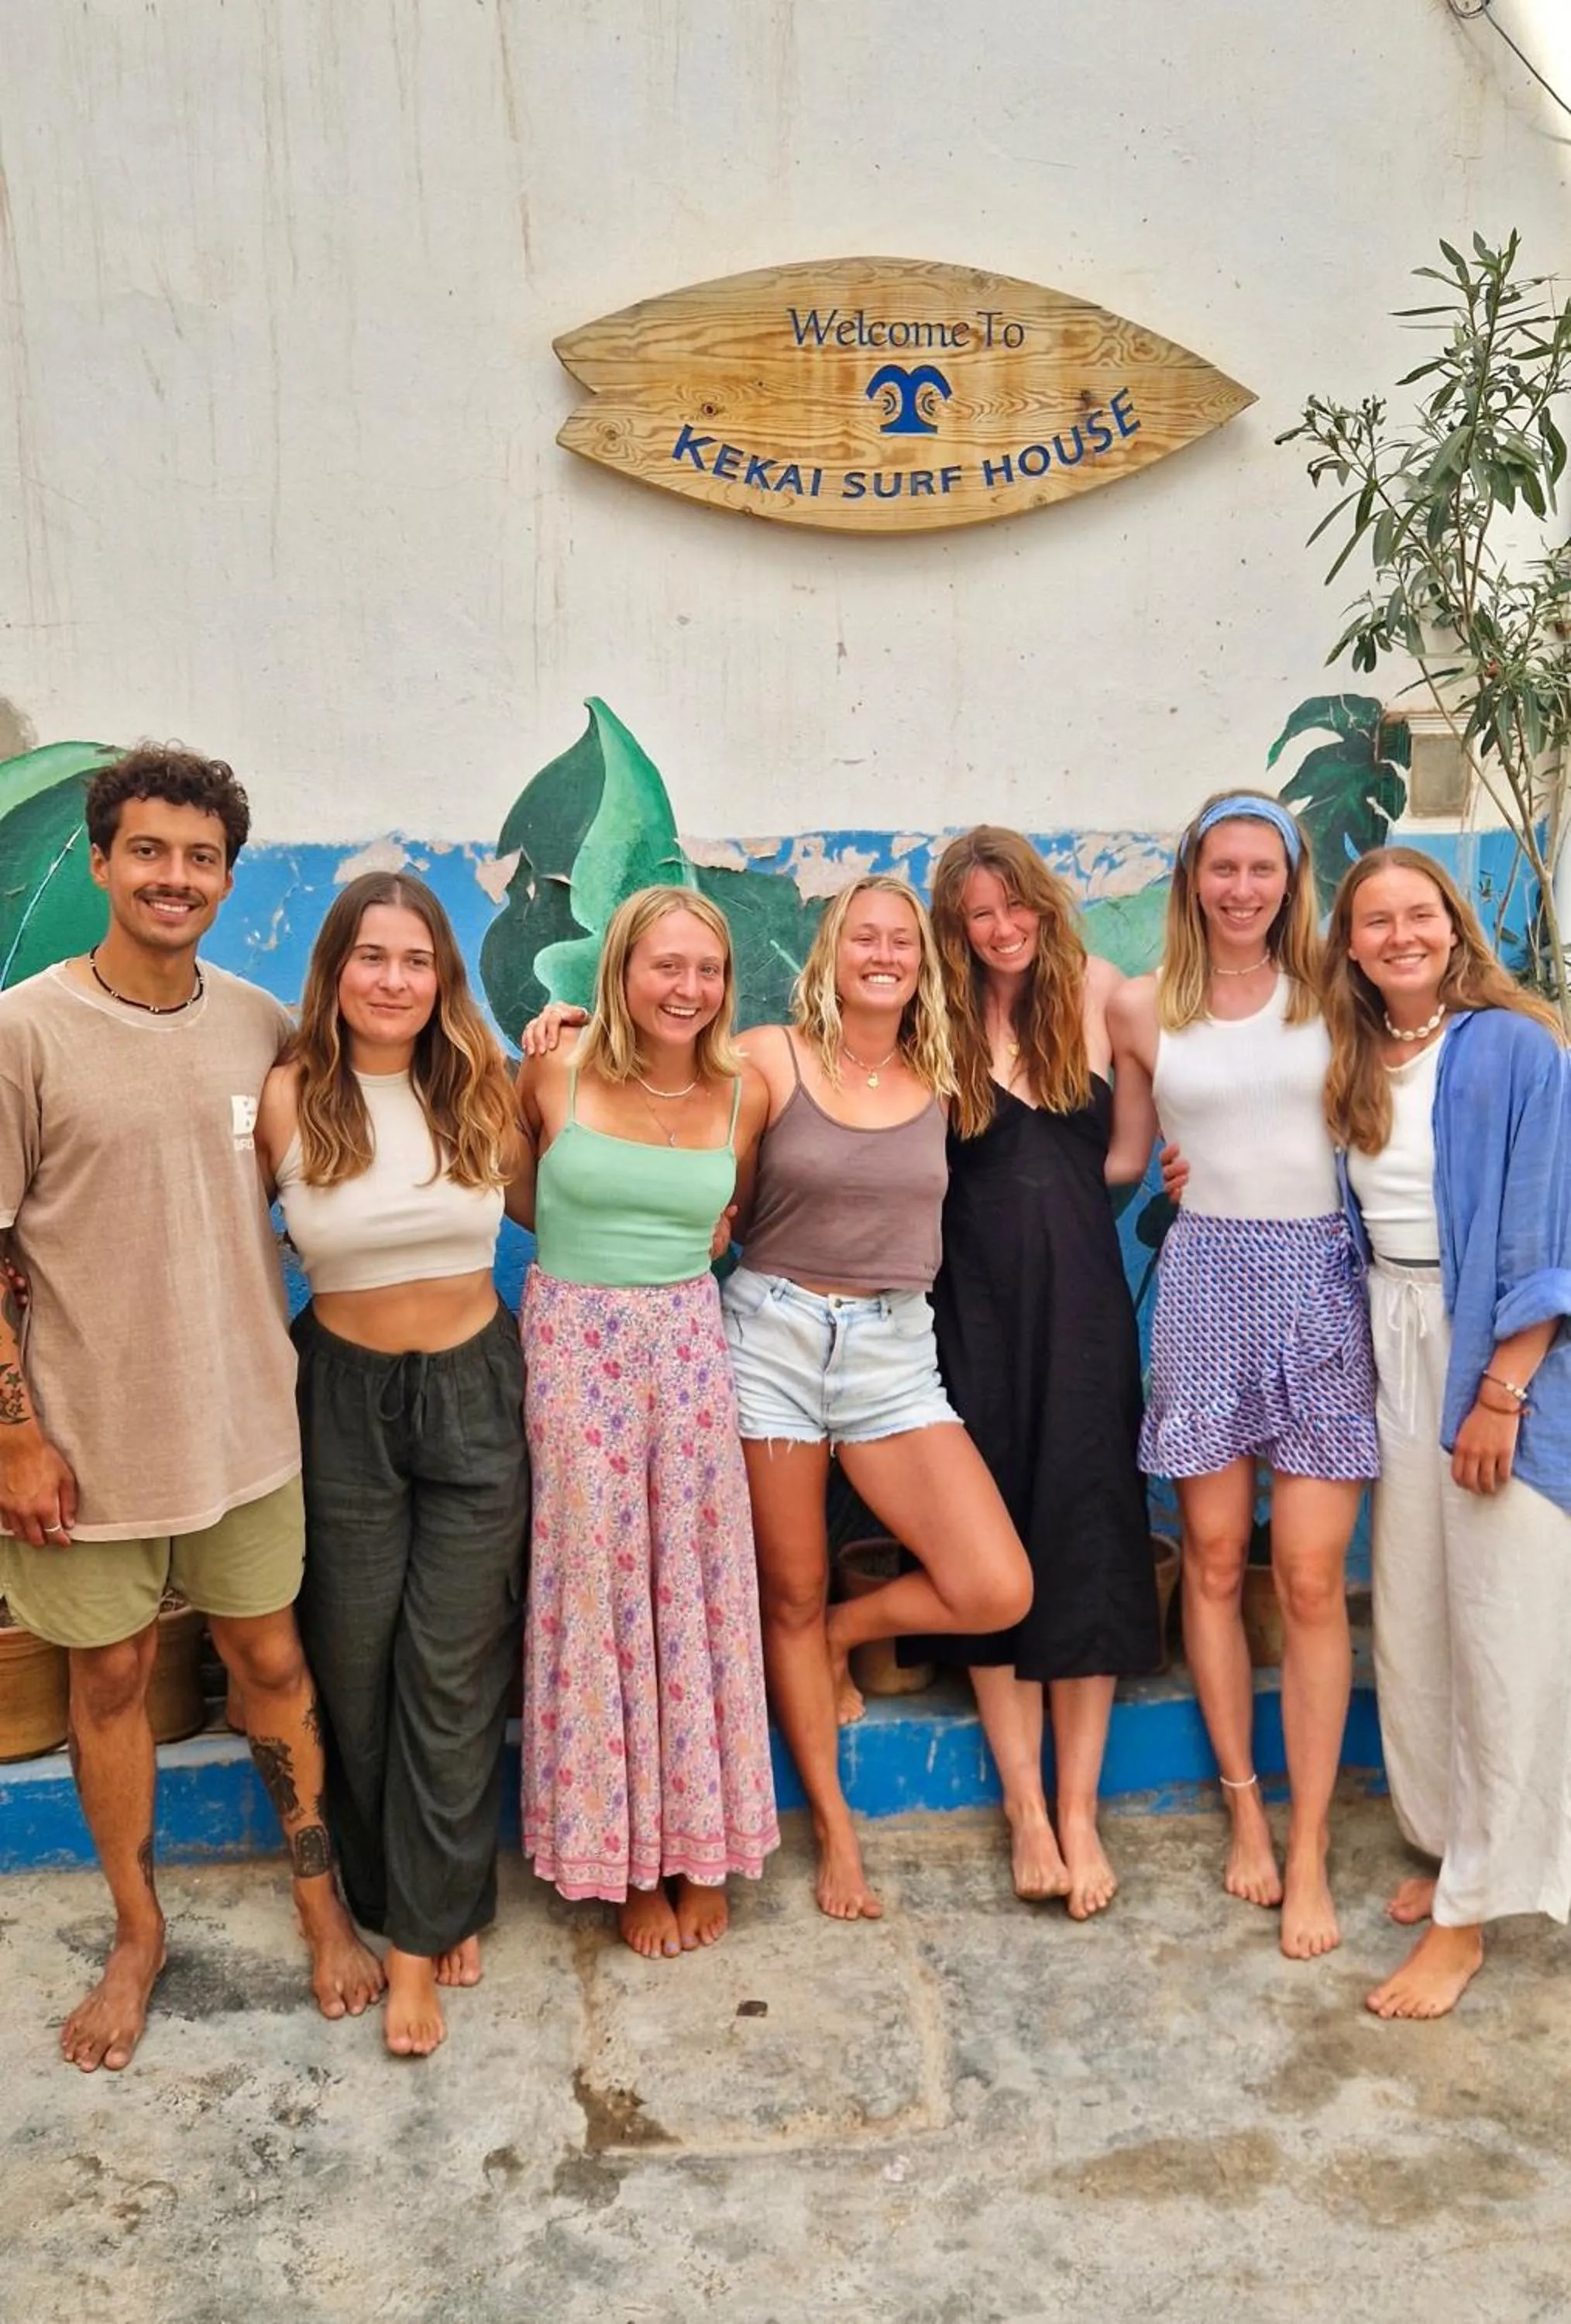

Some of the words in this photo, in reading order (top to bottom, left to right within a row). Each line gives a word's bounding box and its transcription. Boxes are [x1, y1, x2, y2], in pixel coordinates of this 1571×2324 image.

[787, 308, 970, 347] Welcome
[976, 311, 1025, 348] To
[672, 424, 823, 497] KEKAI
[842, 466, 962, 498] SURF
[982, 387, 1142, 486] HOUSE
